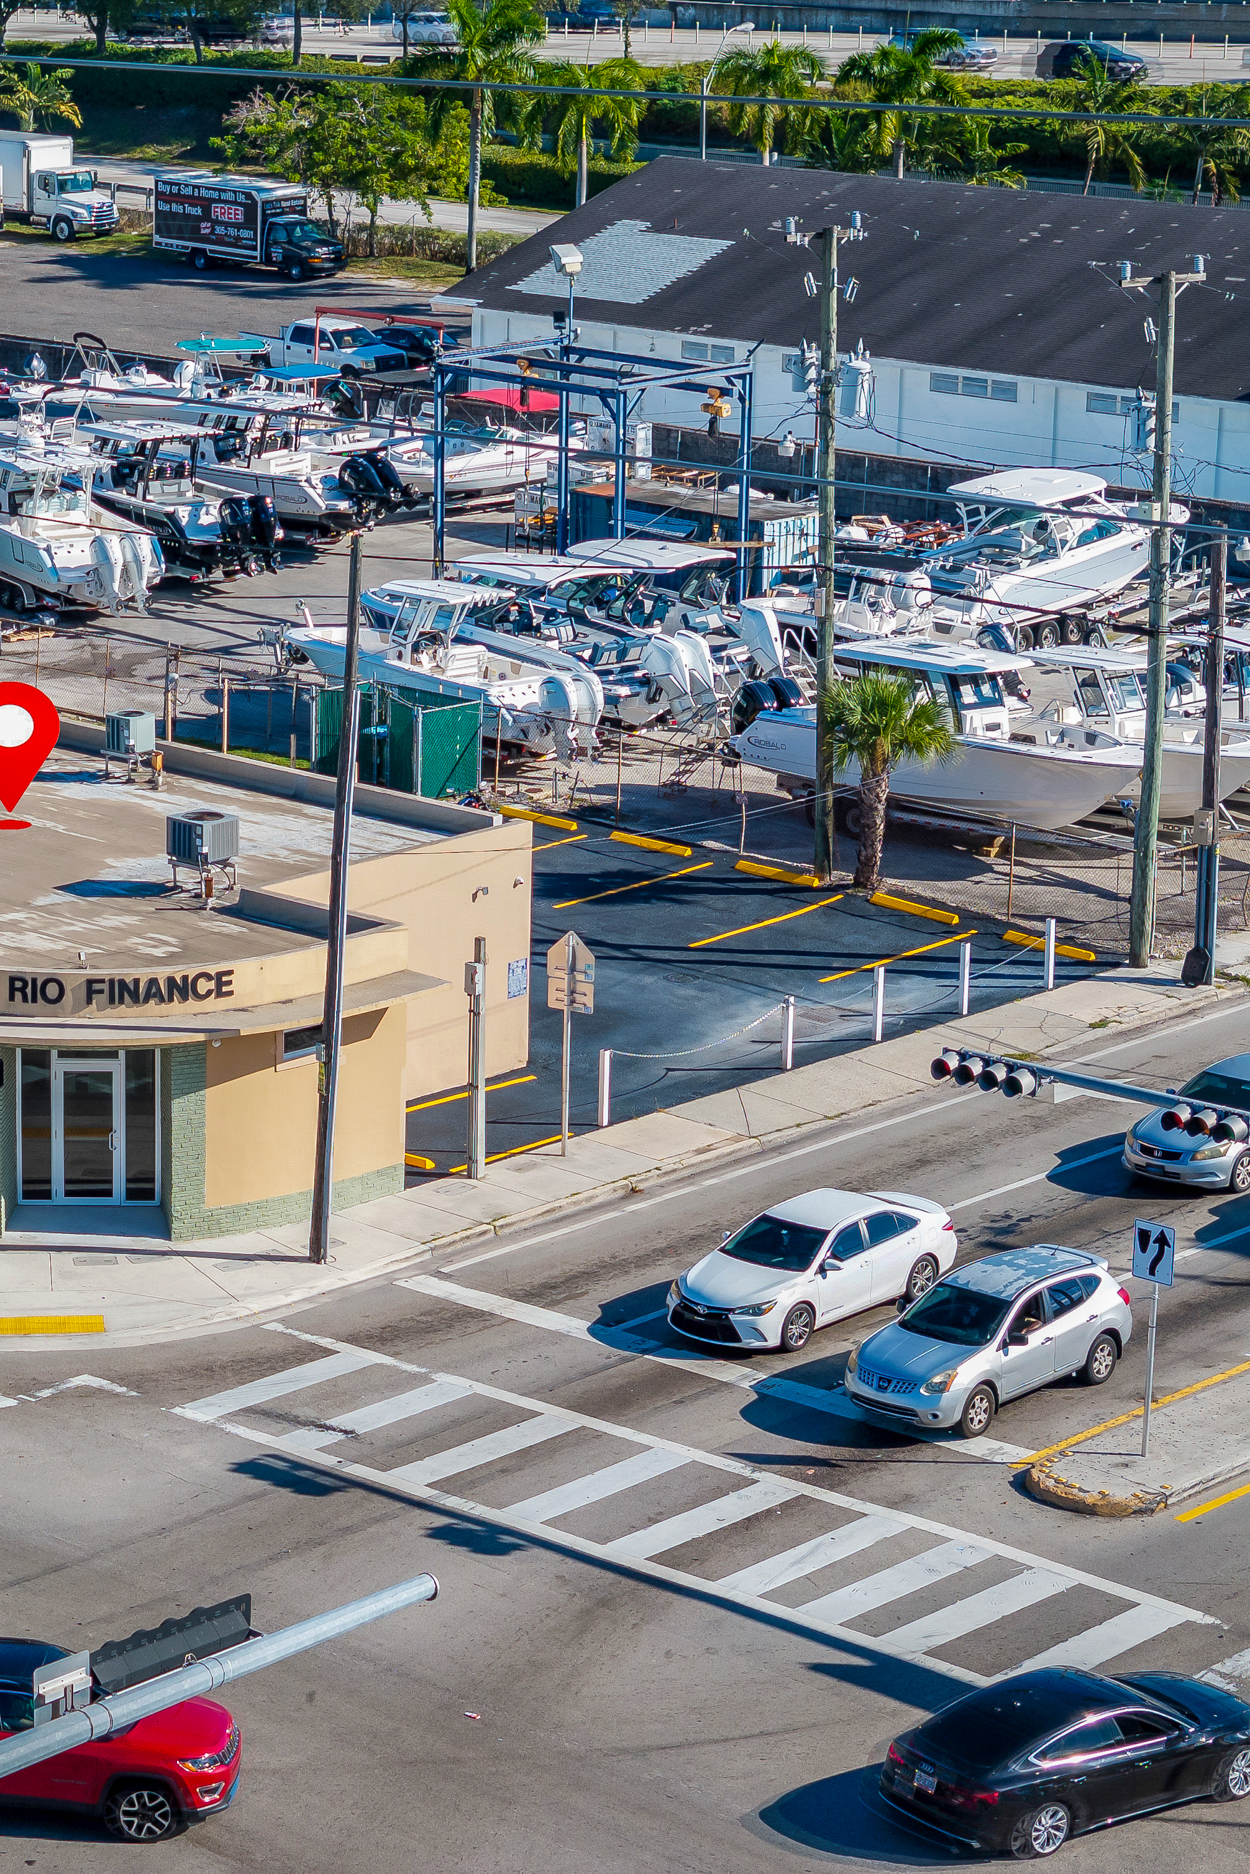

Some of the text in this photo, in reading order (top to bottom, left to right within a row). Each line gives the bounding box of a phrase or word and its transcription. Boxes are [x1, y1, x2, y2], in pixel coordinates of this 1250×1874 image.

[158, 181, 170, 195] Buy
[171, 185, 179, 194] or
[180, 184, 193, 196] Sell
[193, 188, 199, 197] a
[200, 187, 219, 199] Home
[220, 190, 235, 201] with
[158, 200, 203, 216] Use this Truck
[212, 205, 244, 221] FREE!
[753, 738, 787, 750] ROBALO
[8, 975, 66, 1005] RIO
[86, 968, 235, 1006] FINANCE
